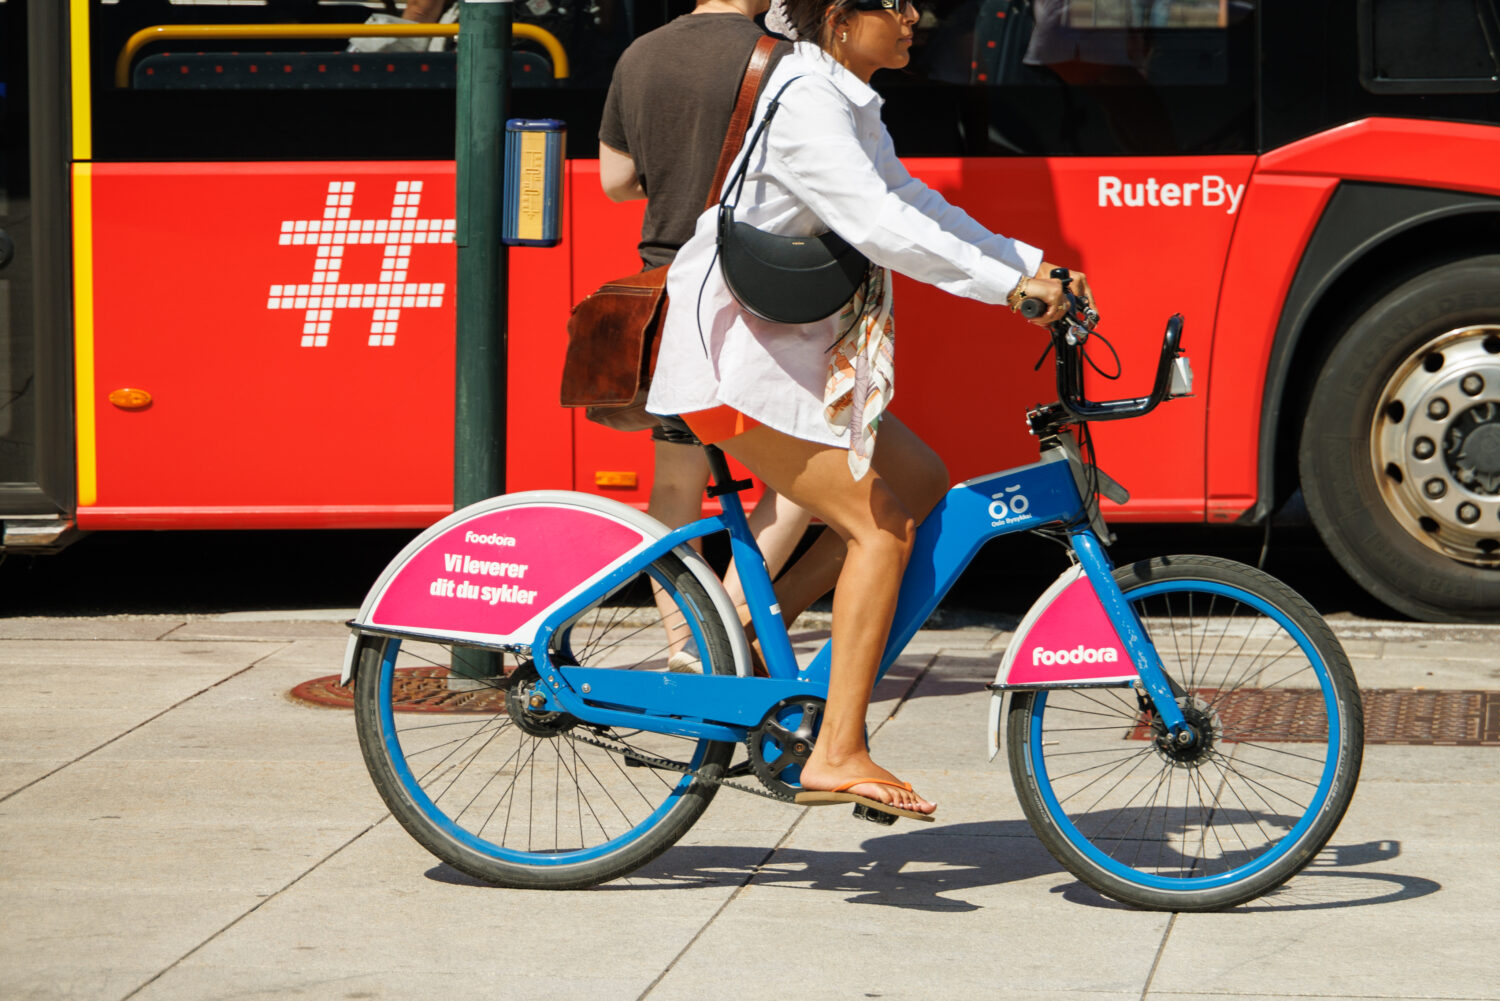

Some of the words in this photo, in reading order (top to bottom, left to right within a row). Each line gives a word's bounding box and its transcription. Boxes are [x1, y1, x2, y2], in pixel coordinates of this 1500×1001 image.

[1098, 175, 1245, 214] RuterBy
[465, 531, 516, 547] foodora
[444, 553, 462, 573] Vi
[463, 555, 528, 578] leverer
[430, 578, 455, 597] dit
[456, 580, 480, 599] du
[480, 584, 538, 605] sykler
[1032, 645, 1118, 666] foodora
